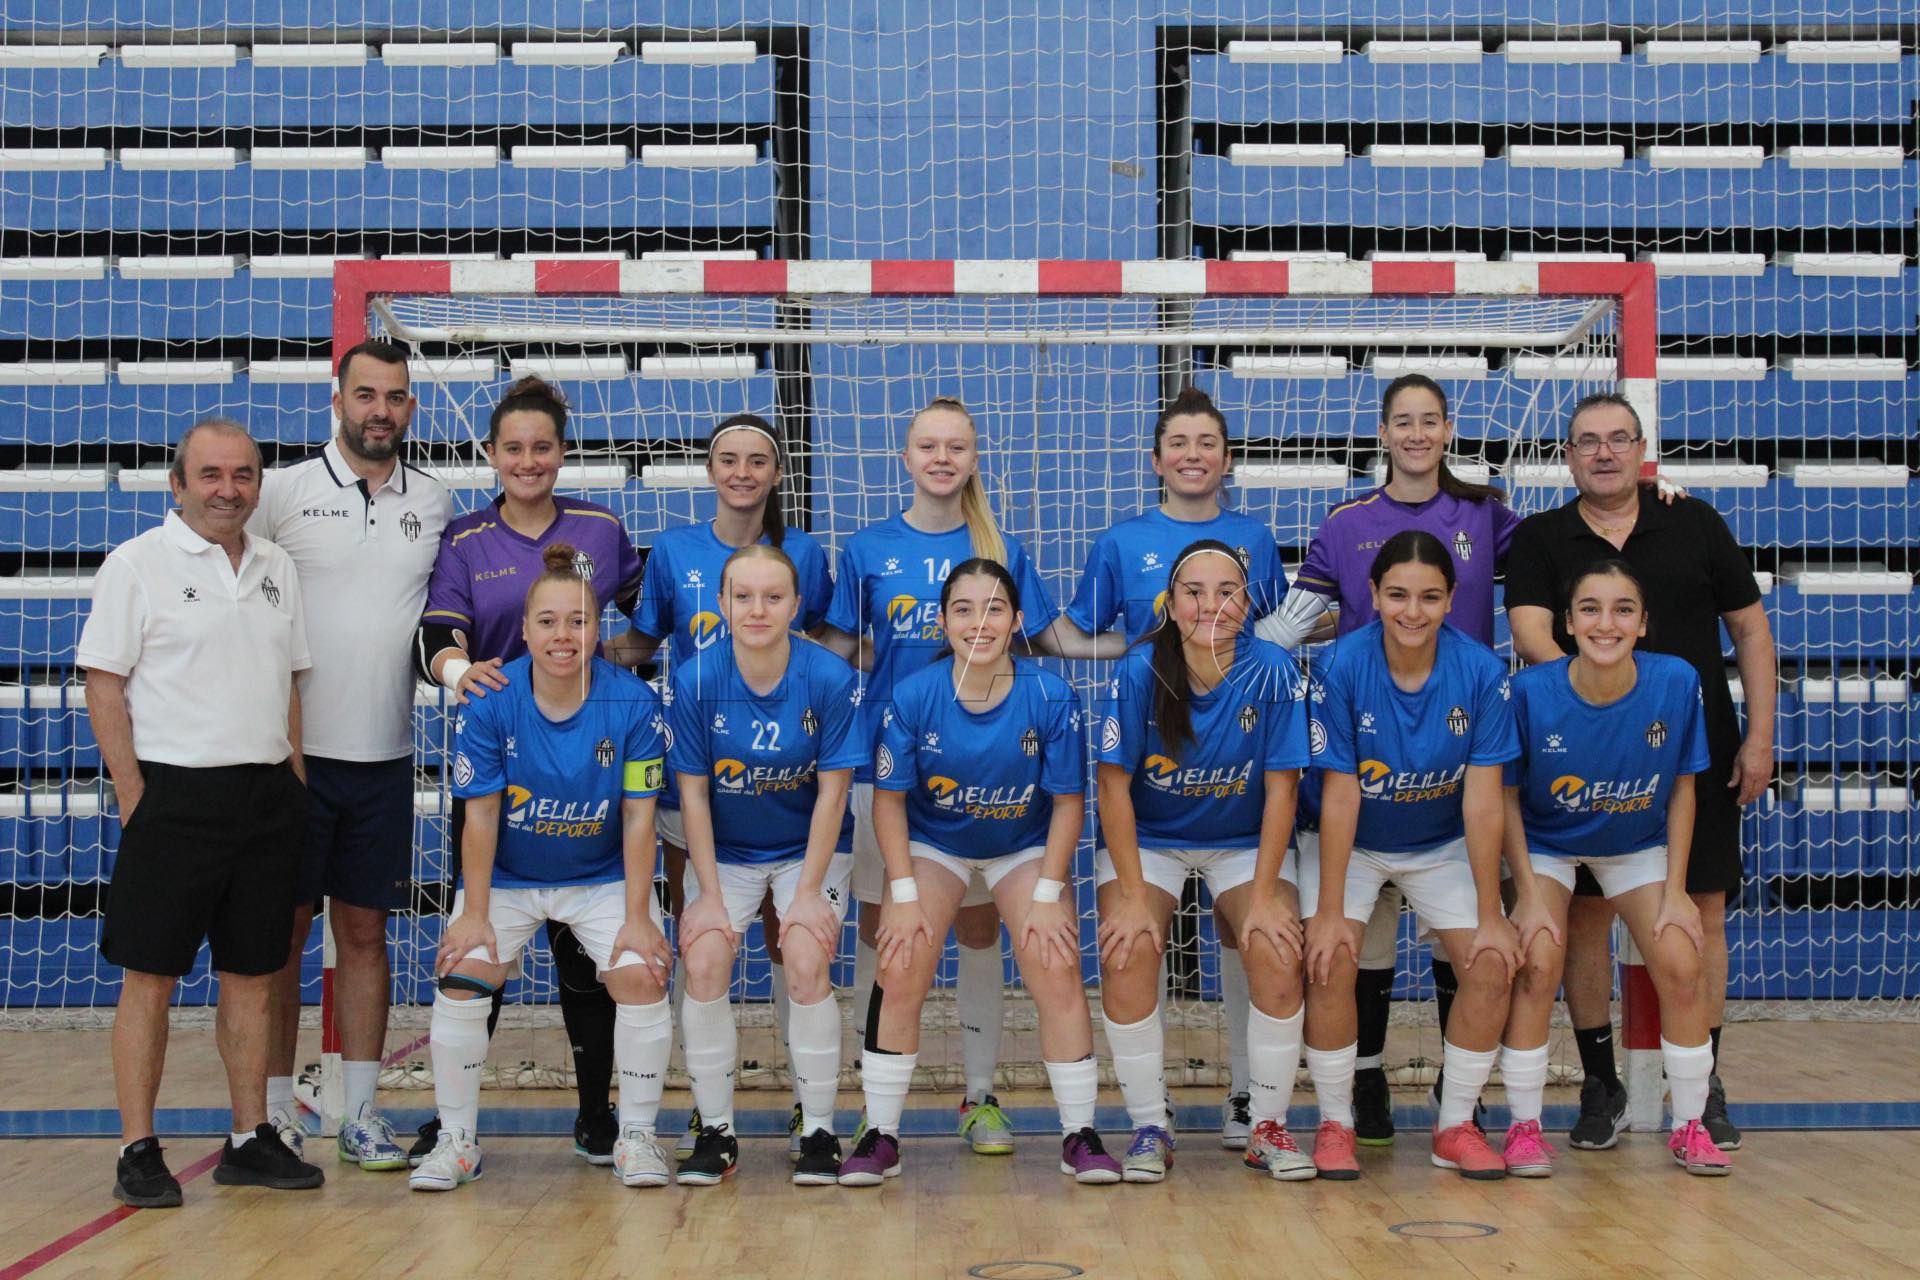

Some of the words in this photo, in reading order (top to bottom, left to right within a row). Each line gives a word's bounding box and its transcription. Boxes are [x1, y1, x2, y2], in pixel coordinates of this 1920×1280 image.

[302, 508, 350, 518] KELME
[1357, 540, 1386, 551] KEL
[474, 566, 518, 582] KELME
[750, 719, 782, 751] 22
[1182, 779, 1249, 799] DEPORTE
[1393, 782, 1459, 804] DEPORTE
[965, 803, 1029, 820] DEPORTE
[1590, 795, 1654, 815] DEPORTE
[534, 819, 604, 839] DEPORTE
[622, 1069, 659, 1079] KELME
